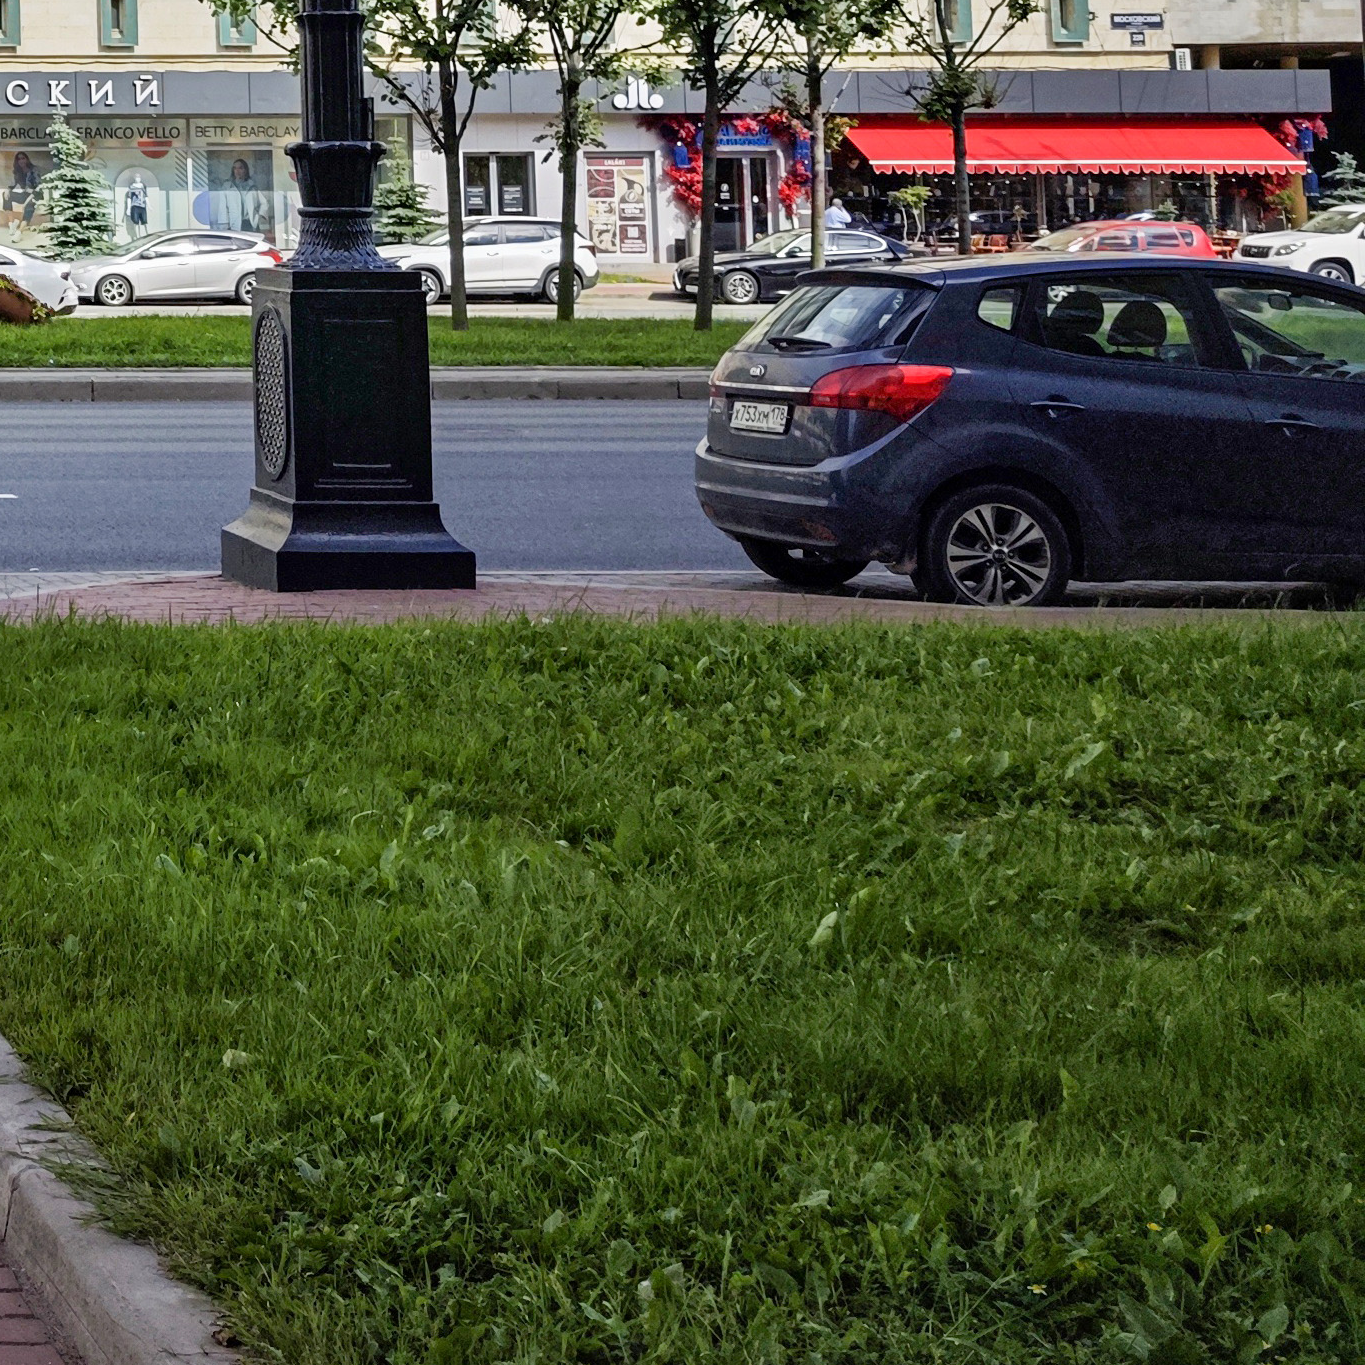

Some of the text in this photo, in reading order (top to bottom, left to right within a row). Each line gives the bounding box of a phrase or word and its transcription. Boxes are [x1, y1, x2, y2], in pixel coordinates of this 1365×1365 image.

[0, 127, 58, 139] BARCLA
[136, 126, 181, 139] VELLO
[195, 126, 300, 138] BETTY BARCLAY
